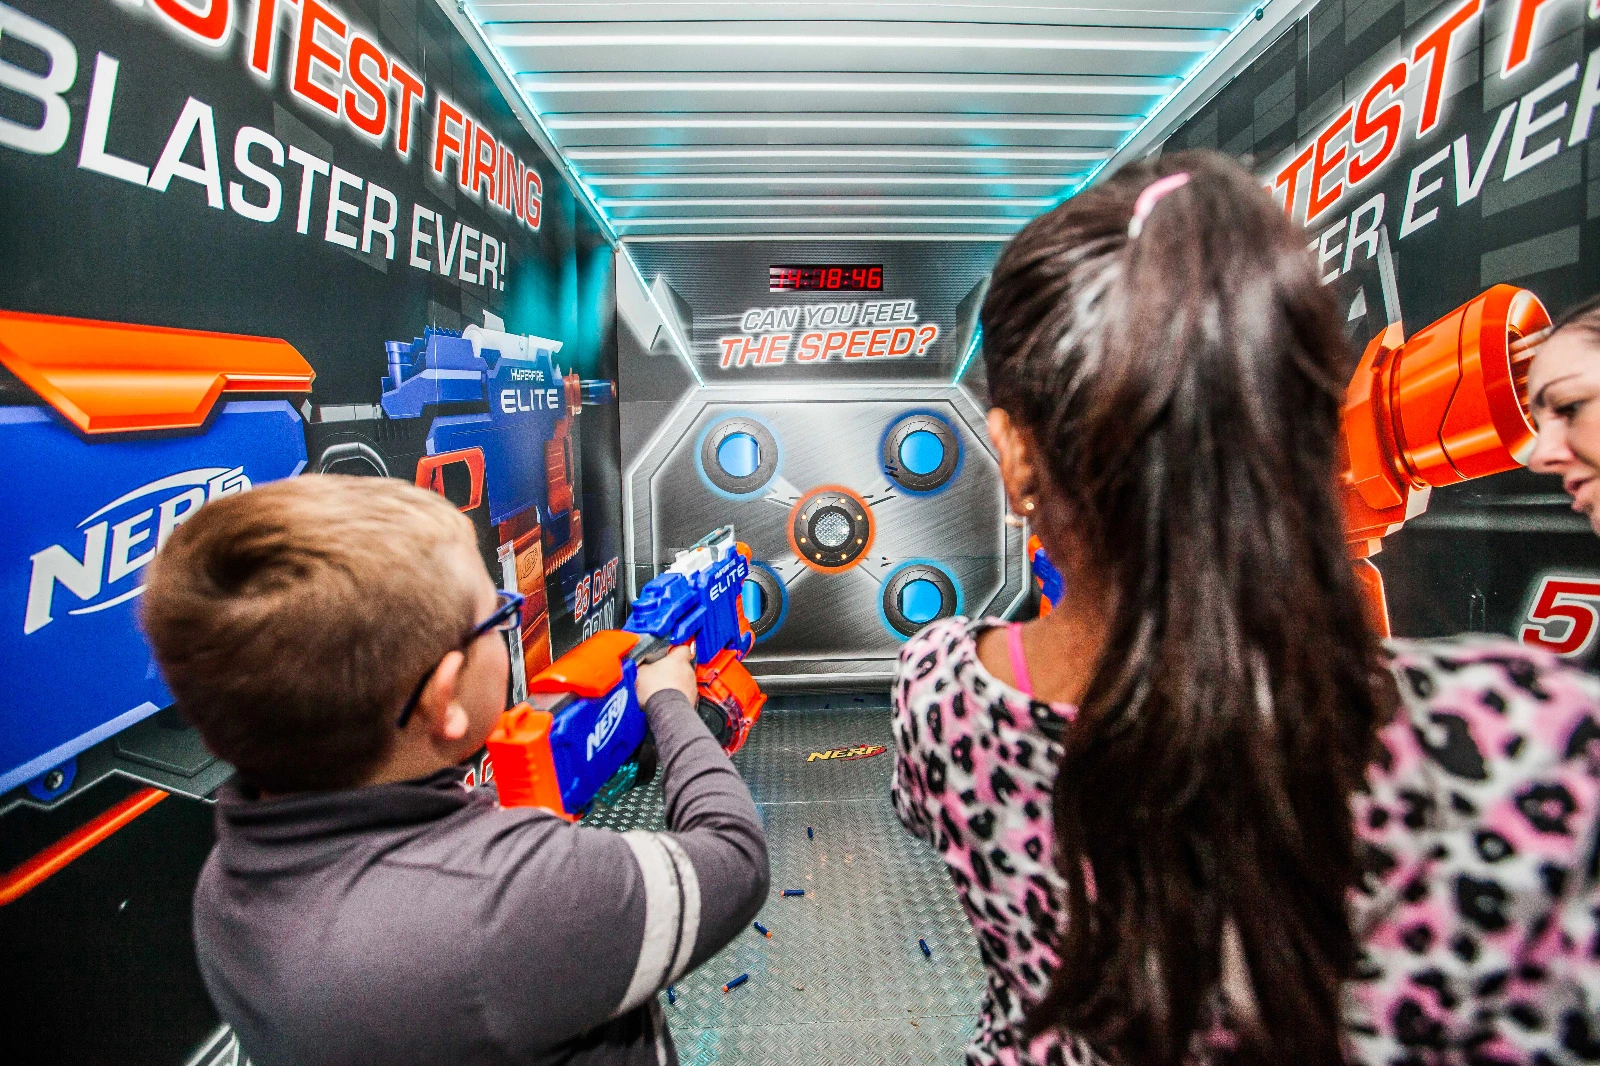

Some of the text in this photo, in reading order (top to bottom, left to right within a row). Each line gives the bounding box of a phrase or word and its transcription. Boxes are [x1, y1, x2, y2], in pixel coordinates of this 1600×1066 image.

[0, 4, 507, 292] BLASTER EVER!
[432, 95, 543, 232] FIRING
[778, 267, 882, 289] 14:18:46
[742, 301, 918, 332] CAN YOU FEEL
[719, 325, 938, 368] THE SPEED?
[501, 388, 559, 414] ELITE
[574, 574, 591, 623] 25
[592, 556, 619, 607] DART
[709, 562, 745, 602] ELITE
[807, 745, 885, 762] NERF
